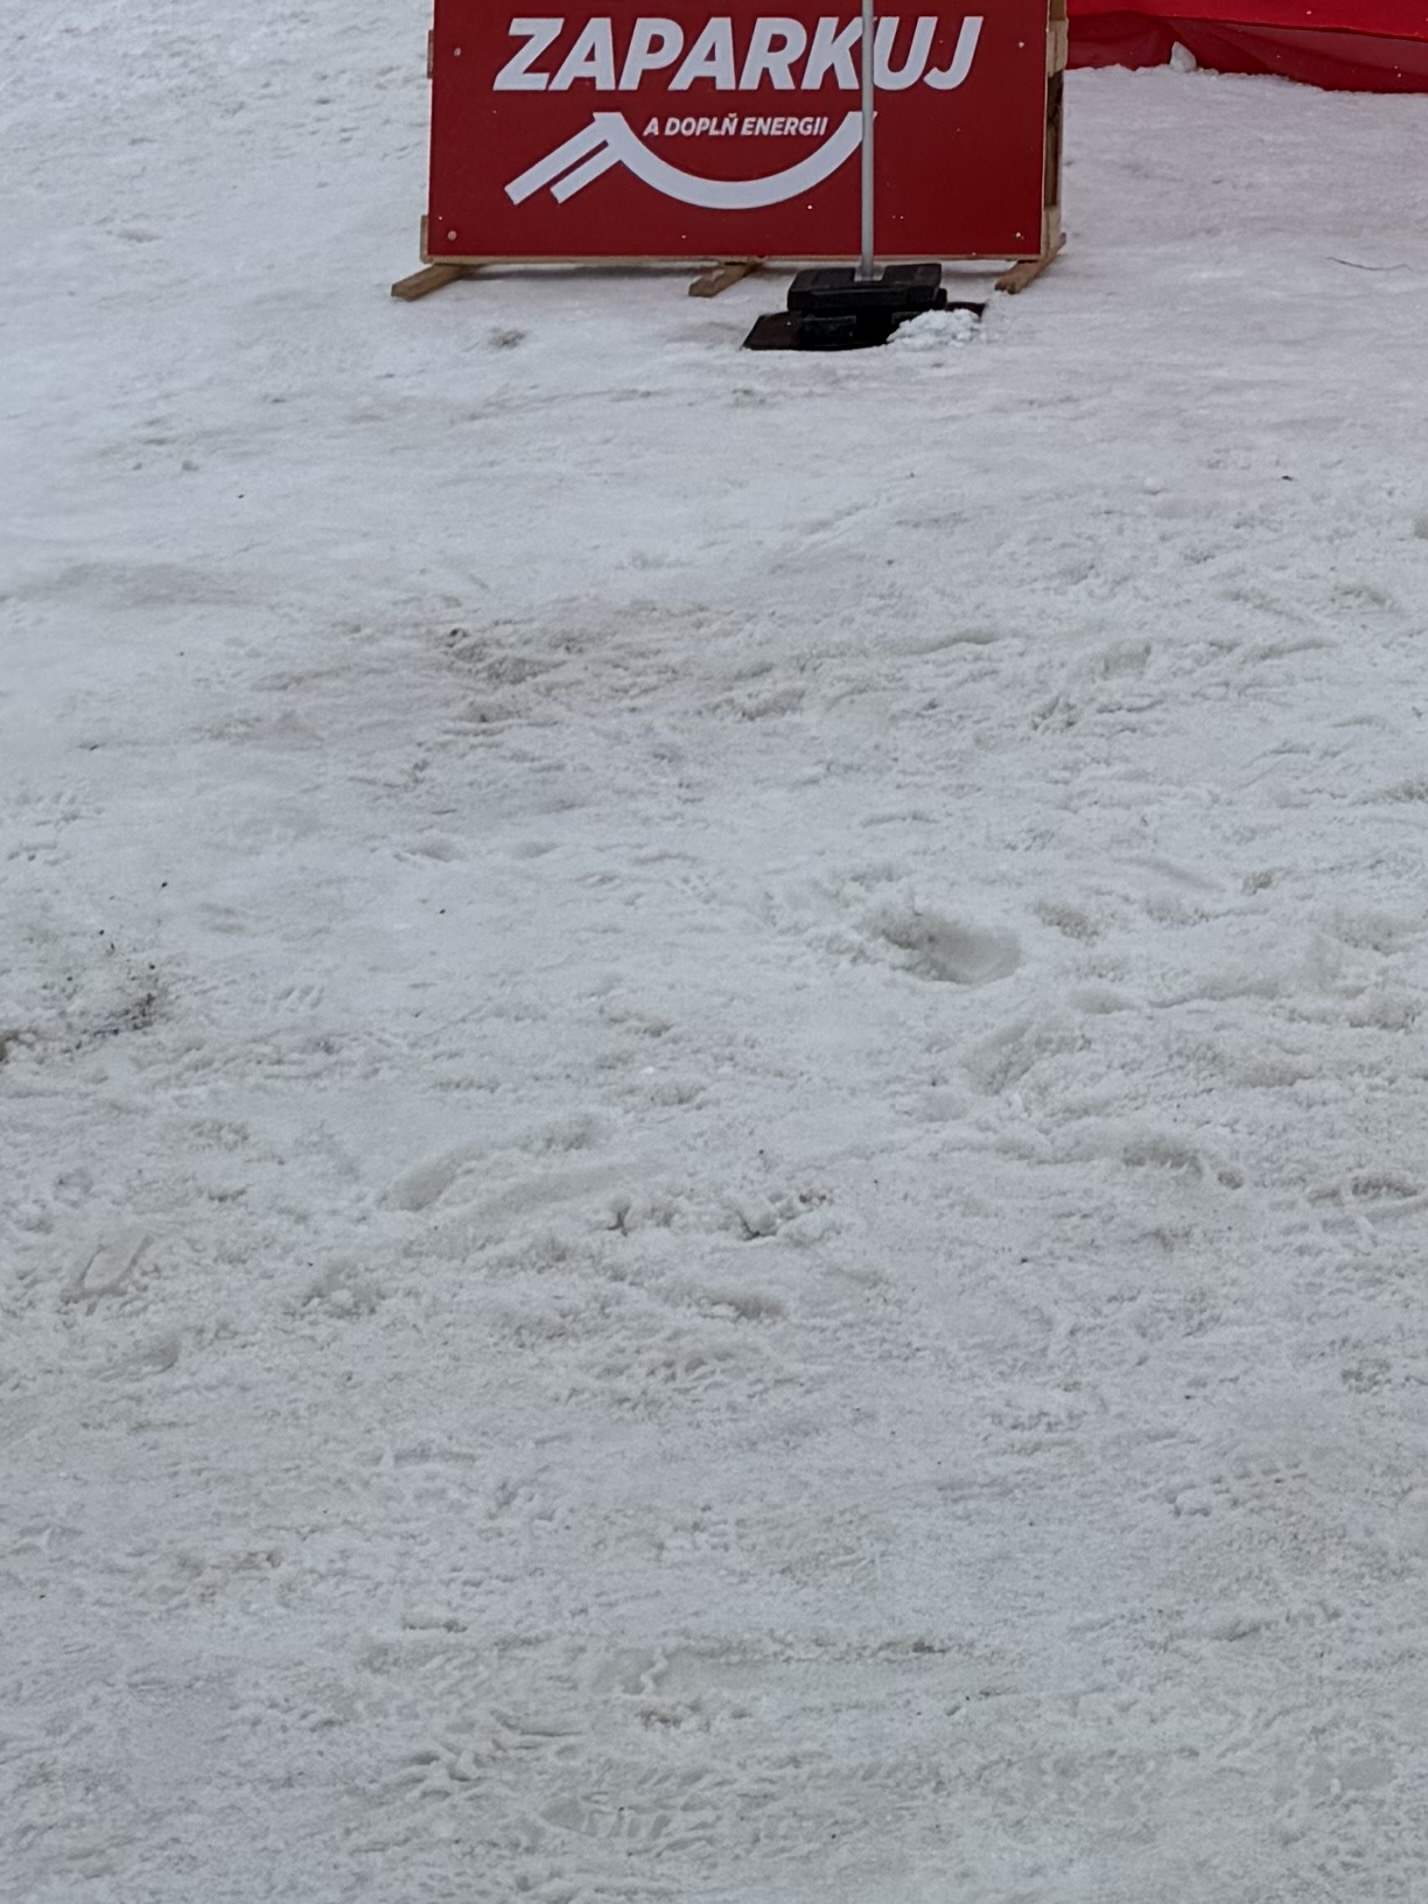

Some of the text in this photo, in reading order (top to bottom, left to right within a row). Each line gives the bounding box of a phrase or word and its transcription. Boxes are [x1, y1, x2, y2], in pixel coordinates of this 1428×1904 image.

[493, 16, 983, 91] ZAPARKUJ
[643, 112, 827, 137] A DOPLŇ ENERGII
